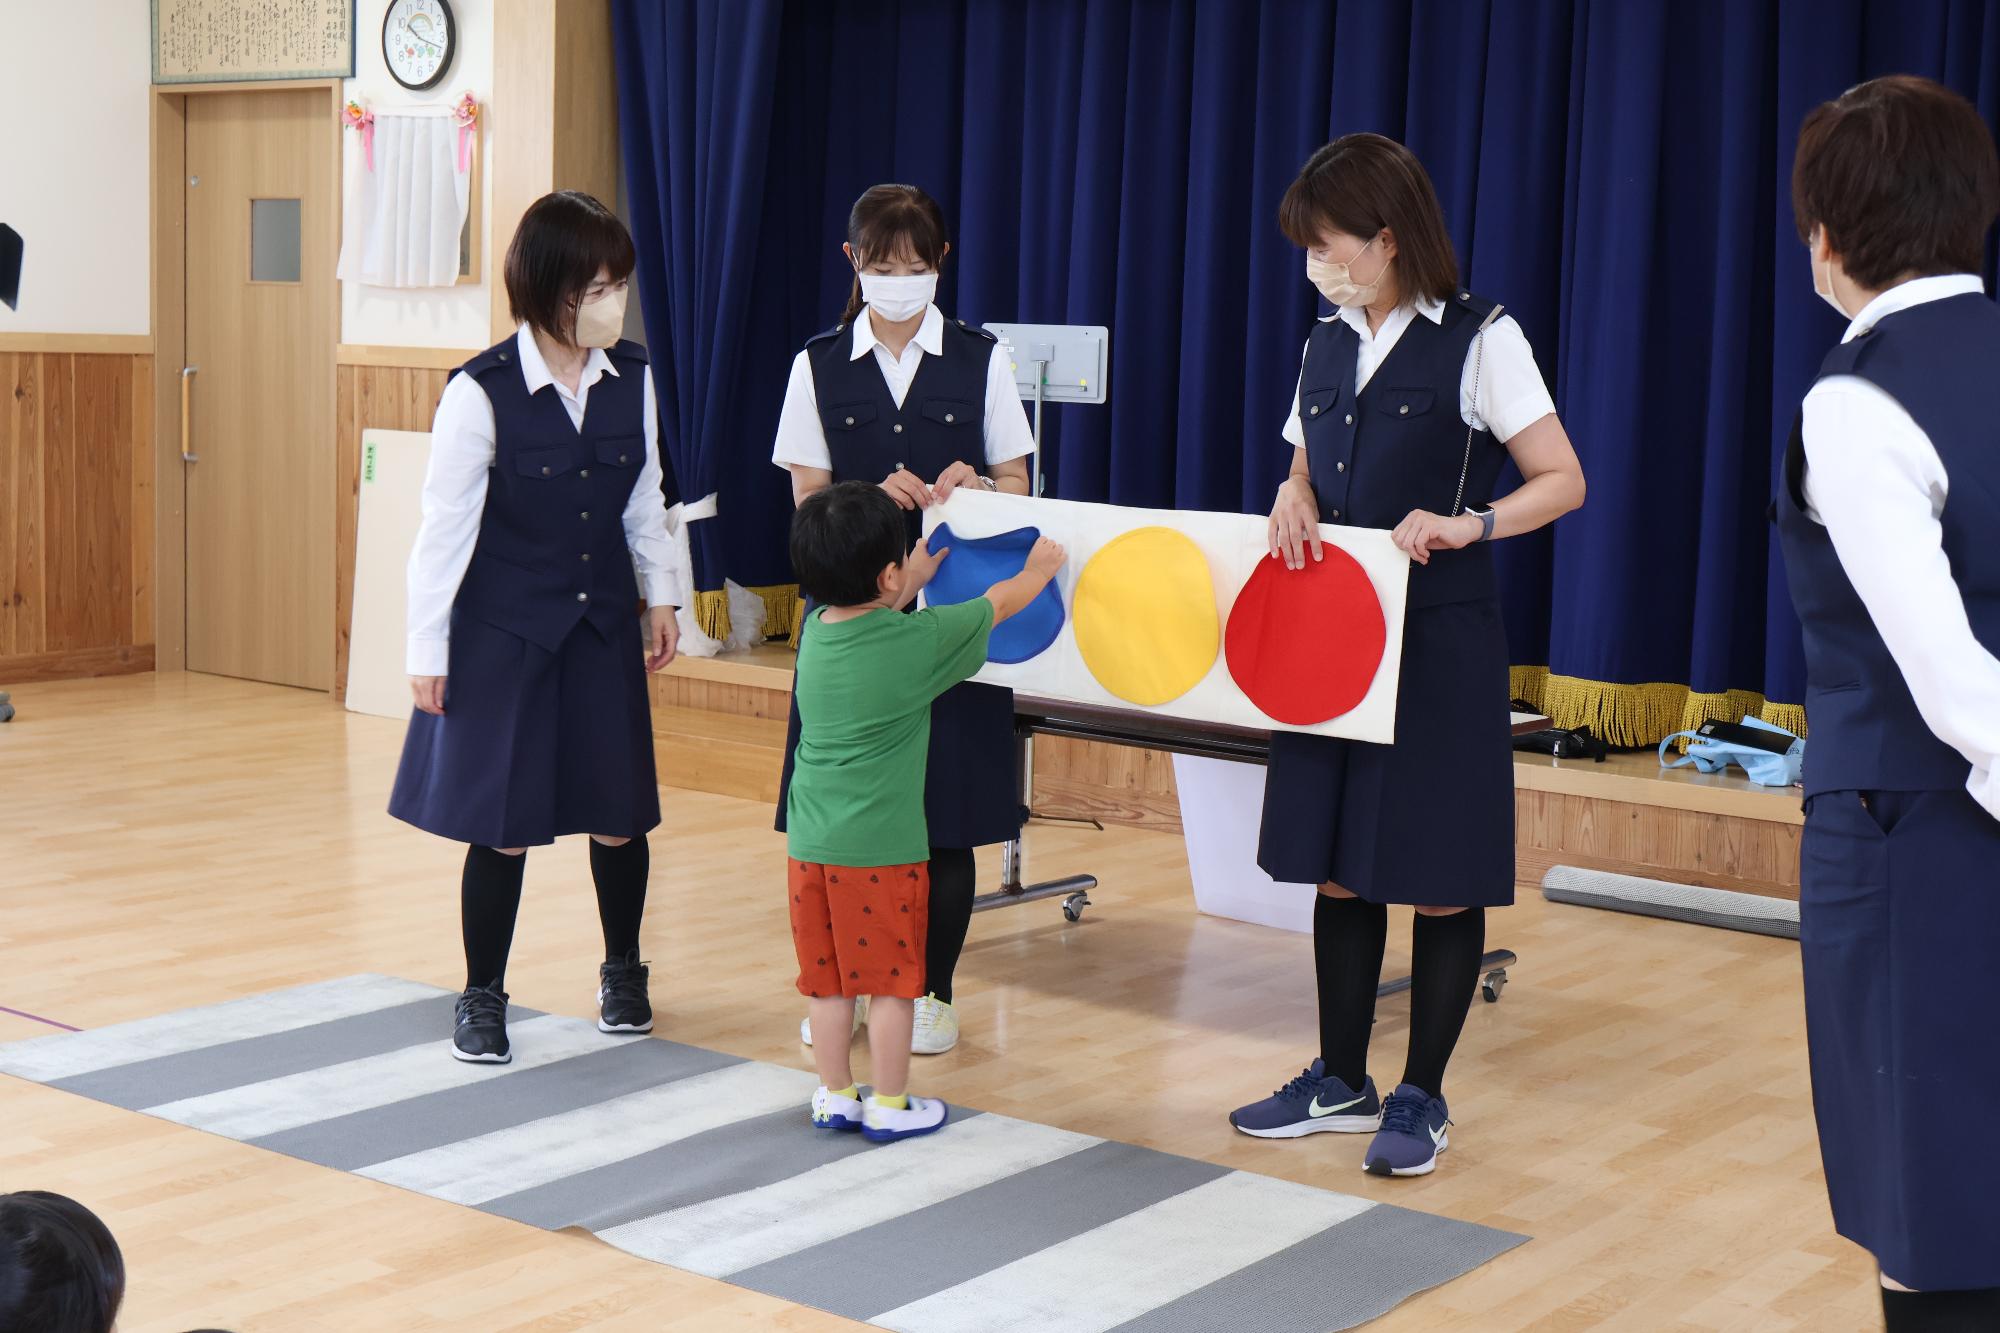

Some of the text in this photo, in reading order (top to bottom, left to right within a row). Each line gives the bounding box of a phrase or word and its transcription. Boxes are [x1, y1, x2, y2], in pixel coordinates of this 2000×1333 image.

[406, 4, 412, 16] 11
[417, 0, 424, 10] 12
[398, 17, 406, 29] 10
[436, 14, 442, 26] 2
[395, 34, 401, 46] 9
[440, 32, 445, 43] 3
[398, 50, 404, 62] 8
[436, 48, 442, 60] 4
[407, 61, 412, 73] 7
[418, 66, 423, 77] 6
[428, 60, 434, 72] 5
